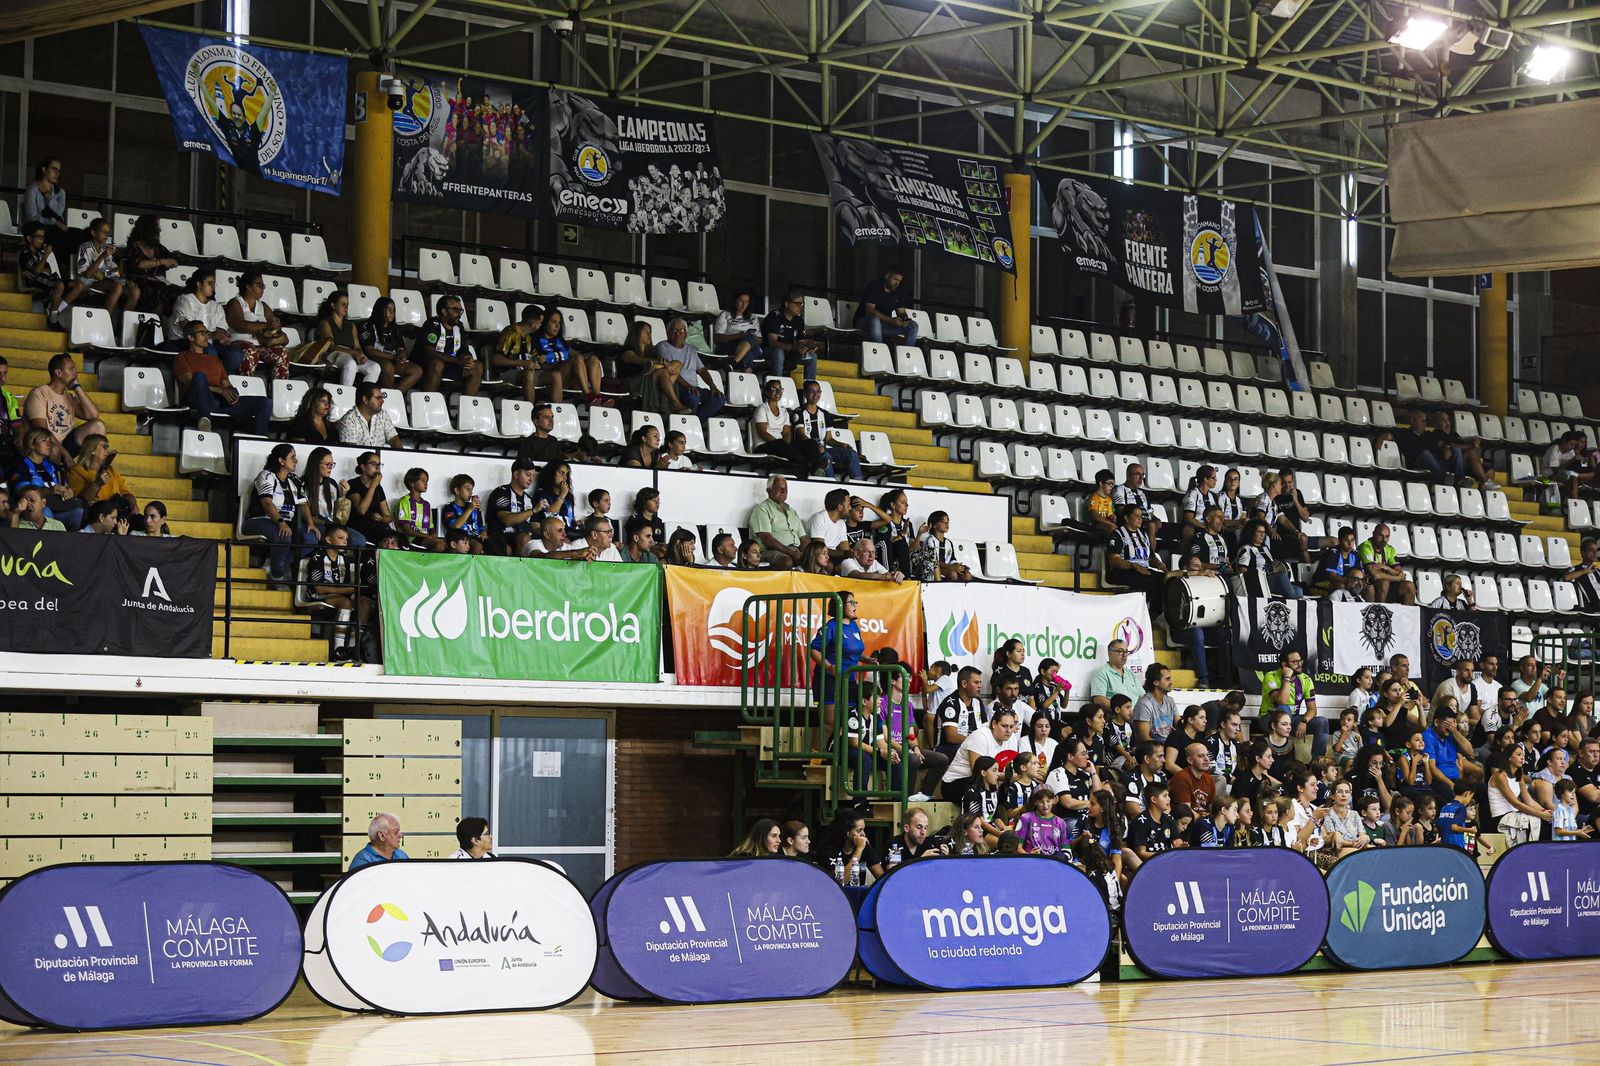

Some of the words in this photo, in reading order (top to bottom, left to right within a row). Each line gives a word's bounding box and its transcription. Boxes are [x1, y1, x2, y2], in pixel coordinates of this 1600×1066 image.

[617, 115, 706, 142] CAMPEONAS
[260, 147, 276, 163] DEL
[272, 130, 284, 149] SOL
[618, 140, 634, 152] LIGA
[442, 182, 533, 202] #FRENTEPANTERAS
[885, 174, 964, 209] CAMPEONAS
[1124, 239, 1168, 269] FRENTE
[1124, 262, 1174, 295] PANTERA
[35, 597, 59, 611] del
[122, 598, 146, 609] Junta
[147, 602, 157, 610] de
[158, 602, 195, 613] Andalucía
[478, 595, 640, 643] Iberdrola
[860, 618, 888, 634] SOL
[1258, 654, 1277, 663] FRENTE
[1241, 888, 1295, 906] MÁLAGA
[1381, 877, 1469, 907] Fundación
[747, 903, 815, 922] MÁLAGA
[1237, 905, 1300, 923] COMPITE
[1509, 907, 1537, 918] Diputación
[1537, 906, 1562, 915] Provincial
[166, 914, 250, 936] MÁLAGA
[420, 910, 542, 947] Andalucía
[1153, 921, 1189, 933] Diputación
[1189, 920, 1221, 930] Provincial
[1382, 906, 1446, 936] Unicaja
[1522, 918, 1530, 926] de
[1530, 917, 1550, 927] Málaga
[746, 922, 823, 942] COMPITE
[1171, 933, 1180, 941] de
[1180, 932, 1205, 943] Málaga
[162, 936, 259, 959] COMPITE
[645, 939, 689, 952] Diputación
[689, 938, 729, 949] Provincial
[754, 943, 762, 951] LA
[762, 942, 792, 950] PROVINCIA
[800, 941, 820, 949] FORMA
[928, 946, 938, 959] la
[940, 945, 977, 958] ciudad
[978, 944, 1023, 957] redonda
[34, 955, 89, 971] Diputación
[90, 954, 139, 967] Provincial
[171, 960, 181, 969] LA
[181, 960, 218, 969] PROVINCIA
[219, 959, 229, 968] EN
[229, 959, 253, 967] FORMA
[669, 952, 680, 962] de
[681, 951, 711, 963] Málaga
[63, 971, 77, 982] de
[78, 970, 115, 983] Málaga
